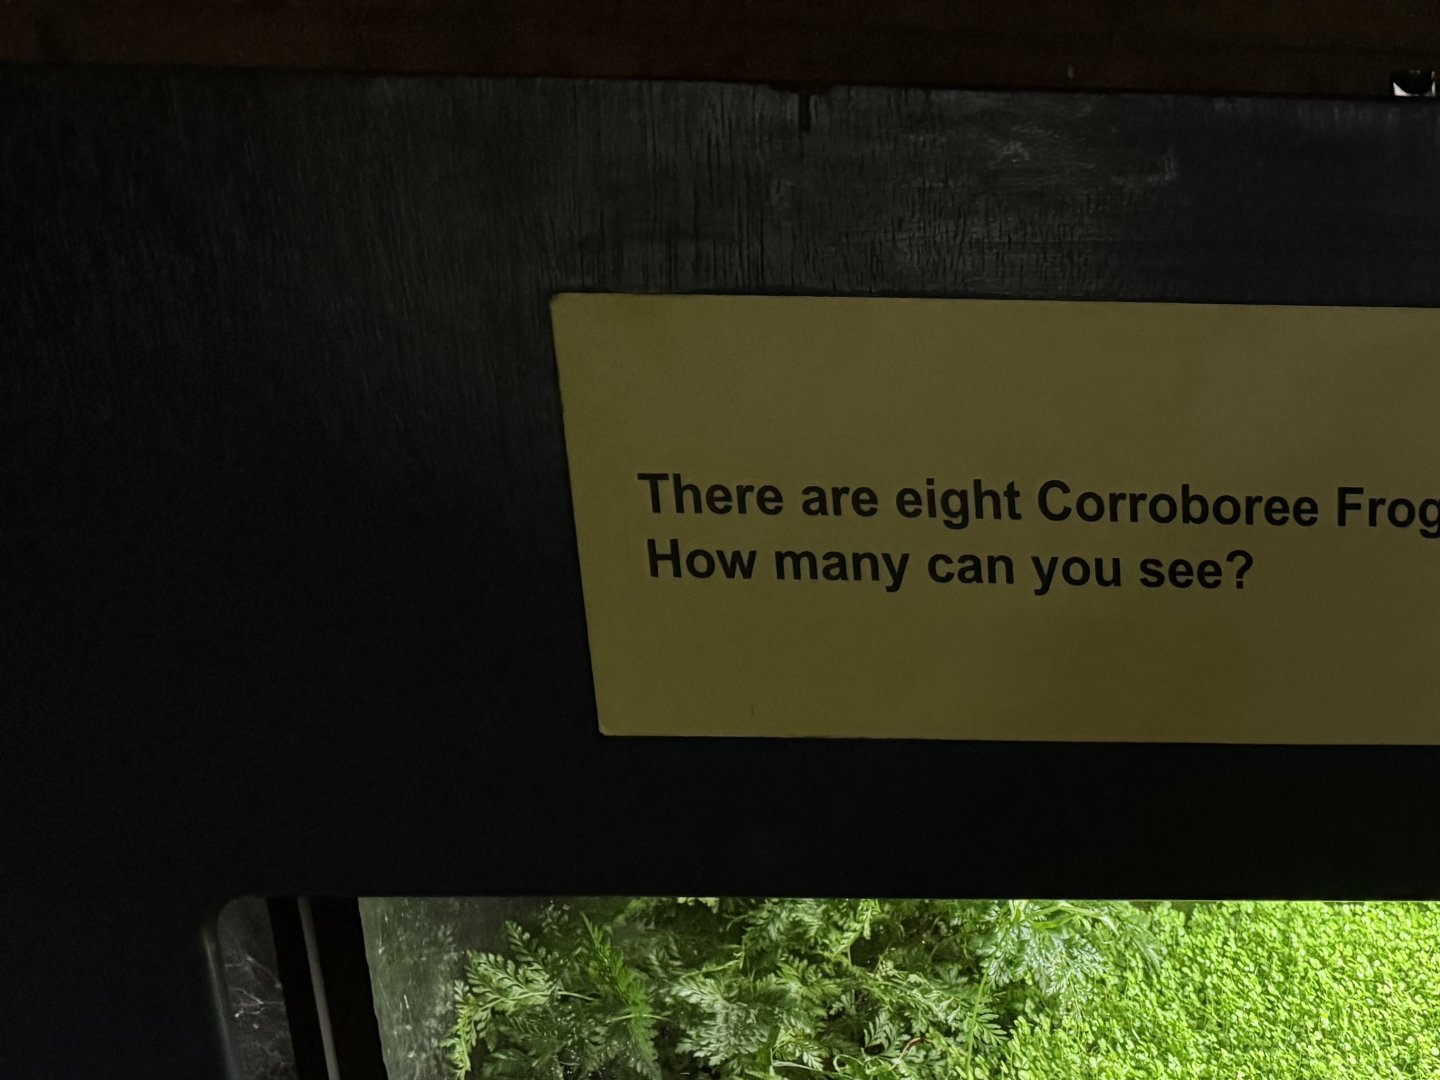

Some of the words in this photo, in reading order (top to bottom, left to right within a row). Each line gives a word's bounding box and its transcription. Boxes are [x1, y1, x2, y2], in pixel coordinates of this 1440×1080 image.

[636, 472, 784, 516] There
[801, 485, 880, 518] are
[895, 477, 1023, 530] eight
[1037, 479, 1319, 528] Corroboree
[646, 538, 758, 580] How
[774, 550, 910, 593] many
[927, 553, 1015, 585] can
[1030, 555, 1122, 597] you
[1139, 549, 1254, 590] see?
